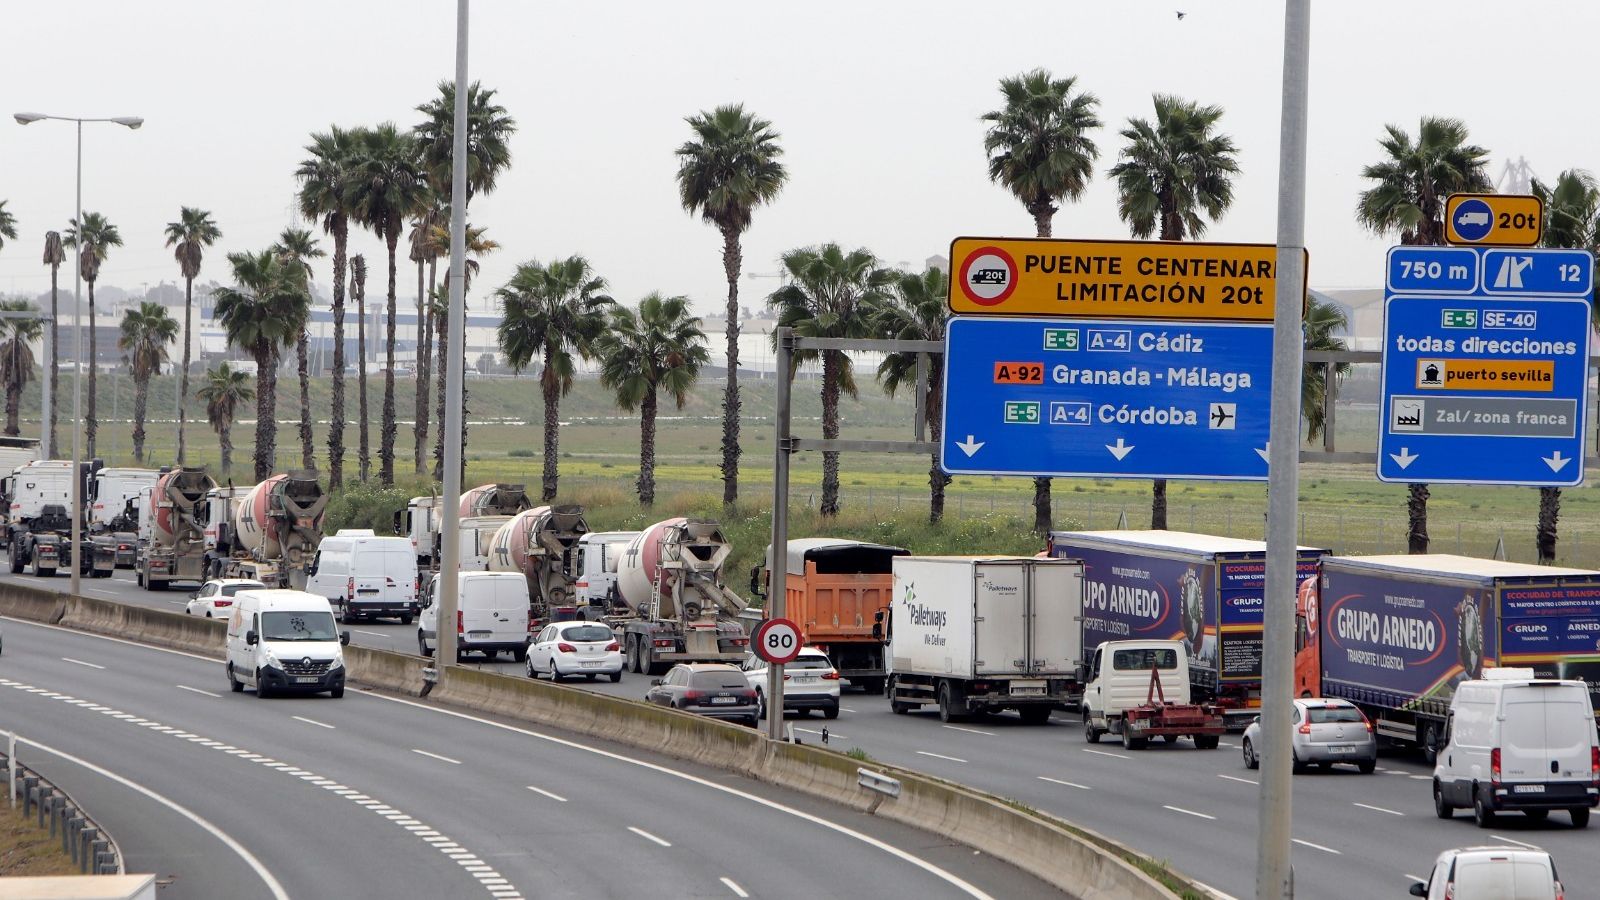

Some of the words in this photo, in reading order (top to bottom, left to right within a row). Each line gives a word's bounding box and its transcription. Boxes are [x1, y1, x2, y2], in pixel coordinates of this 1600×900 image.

[1499, 212, 1536, 230] 20t
[985, 271, 1003, 280] 20t
[1025, 254, 1122, 275] PUENTE
[1137, 257, 1276, 279] CENTENAR
[1400, 261, 1442, 279] 750
[1449, 265, 1468, 280] m
[1558, 264, 1581, 282] 12
[1057, 282, 1206, 304] LIMITACIÓN
[1221, 285, 1263, 305] 20t
[1443, 312, 1475, 326] E-5
[1484, 312, 1535, 328] SE-40
[1045, 332, 1078, 348] E-5
[1091, 333, 1127, 350] A-4
[1138, 332, 1203, 353] Cádiz
[1397, 335, 1455, 353] todas
[1462, 337, 1577, 355] direcciones
[998, 364, 1042, 382] A-92
[1446, 364, 1497, 383] puerto
[1501, 368, 1551, 383] sevilla
[1006, 404, 1038, 421] E-5
[1054, 405, 1088, 422] A-4
[1098, 404, 1197, 426] Córdoba
[1516, 410, 1567, 426] franca
[1083, 578, 1107, 611] UPO
[1110, 584, 1160, 620] ARNEDO
[911, 603, 947, 631] Palletways
[1338, 607, 1379, 644] GRUPO
[1382, 614, 1436, 652] ARNEDO
[1515, 625, 1547, 633] GRUPO
[1568, 623, 1600, 631] ARNED
[768, 634, 793, 648] 80
[1347, 648, 1376, 667] TRANSPORTE
[1380, 652, 1404, 671] LOGÍSTICA
